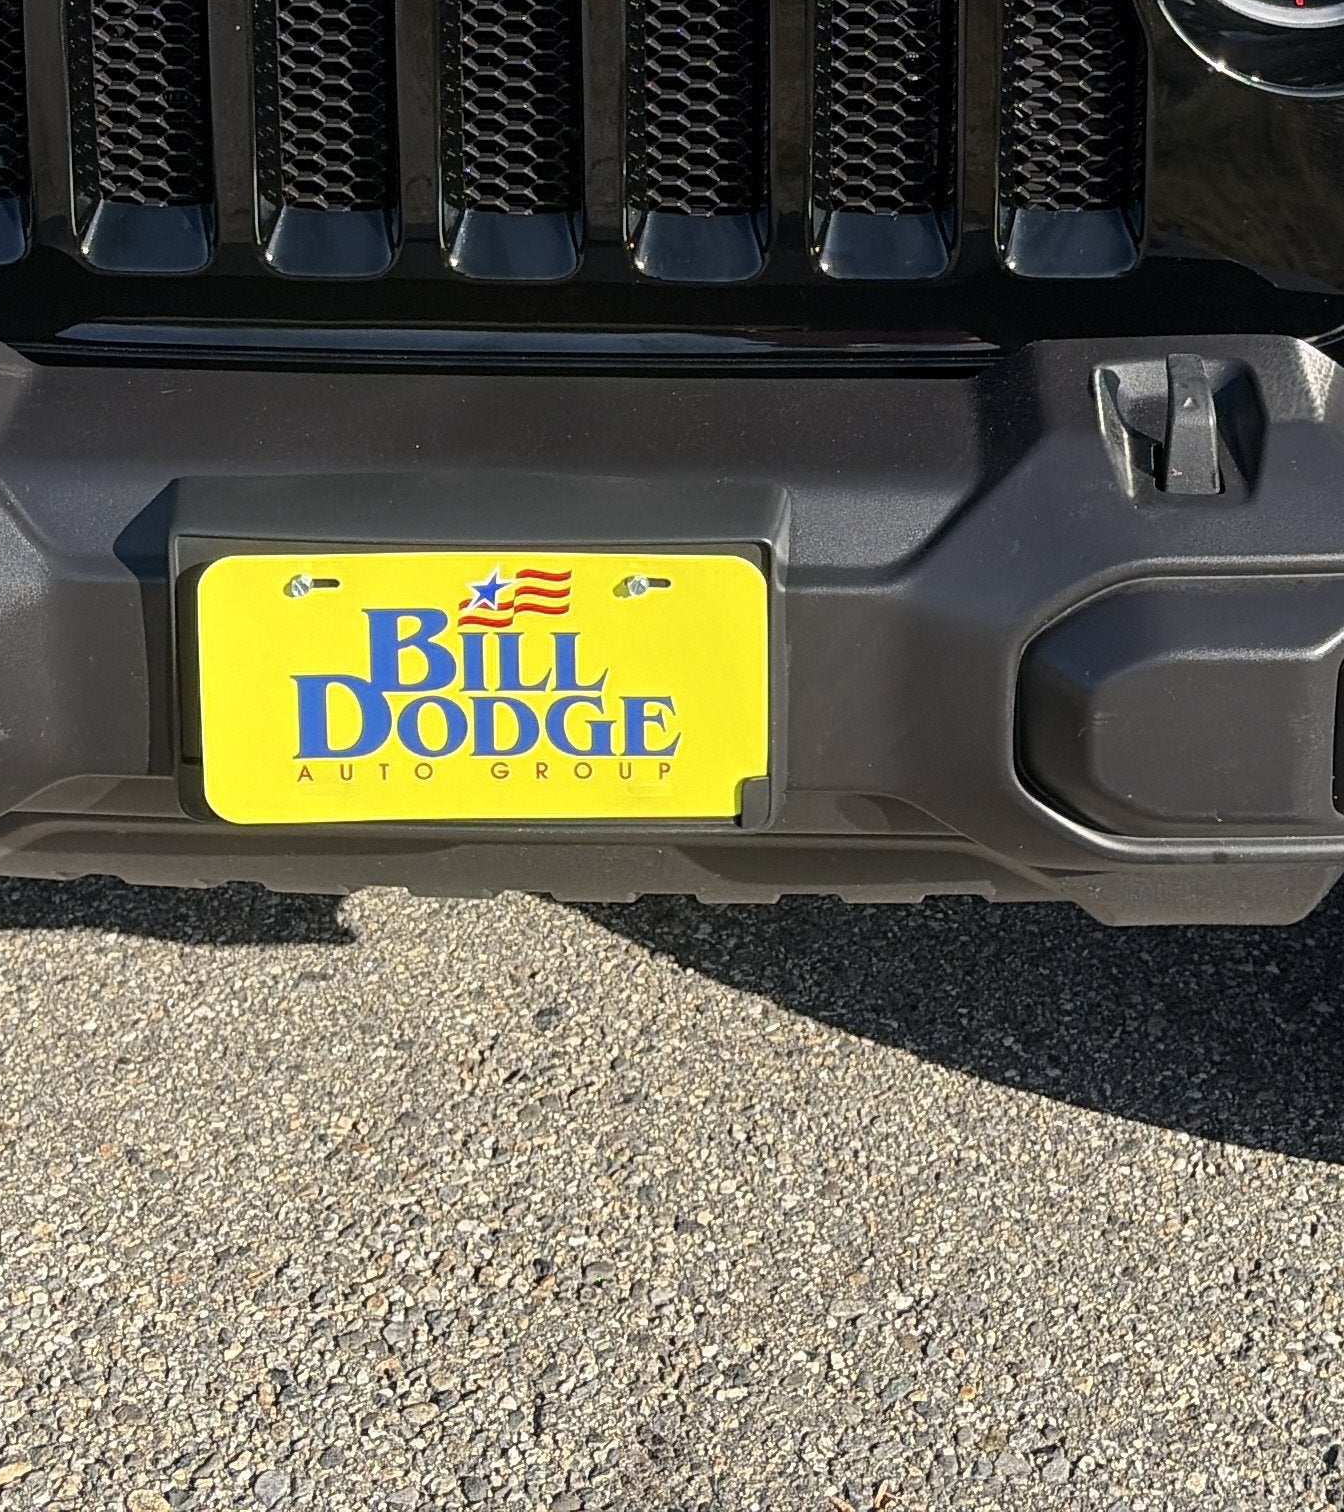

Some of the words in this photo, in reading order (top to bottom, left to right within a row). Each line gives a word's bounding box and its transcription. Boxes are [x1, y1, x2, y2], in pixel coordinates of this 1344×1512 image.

[361, 608, 609, 692] BILL
[290, 674, 682, 759] DODGE
[297, 761, 434, 782] AUTO
[490, 761, 672, 781] GROUP
